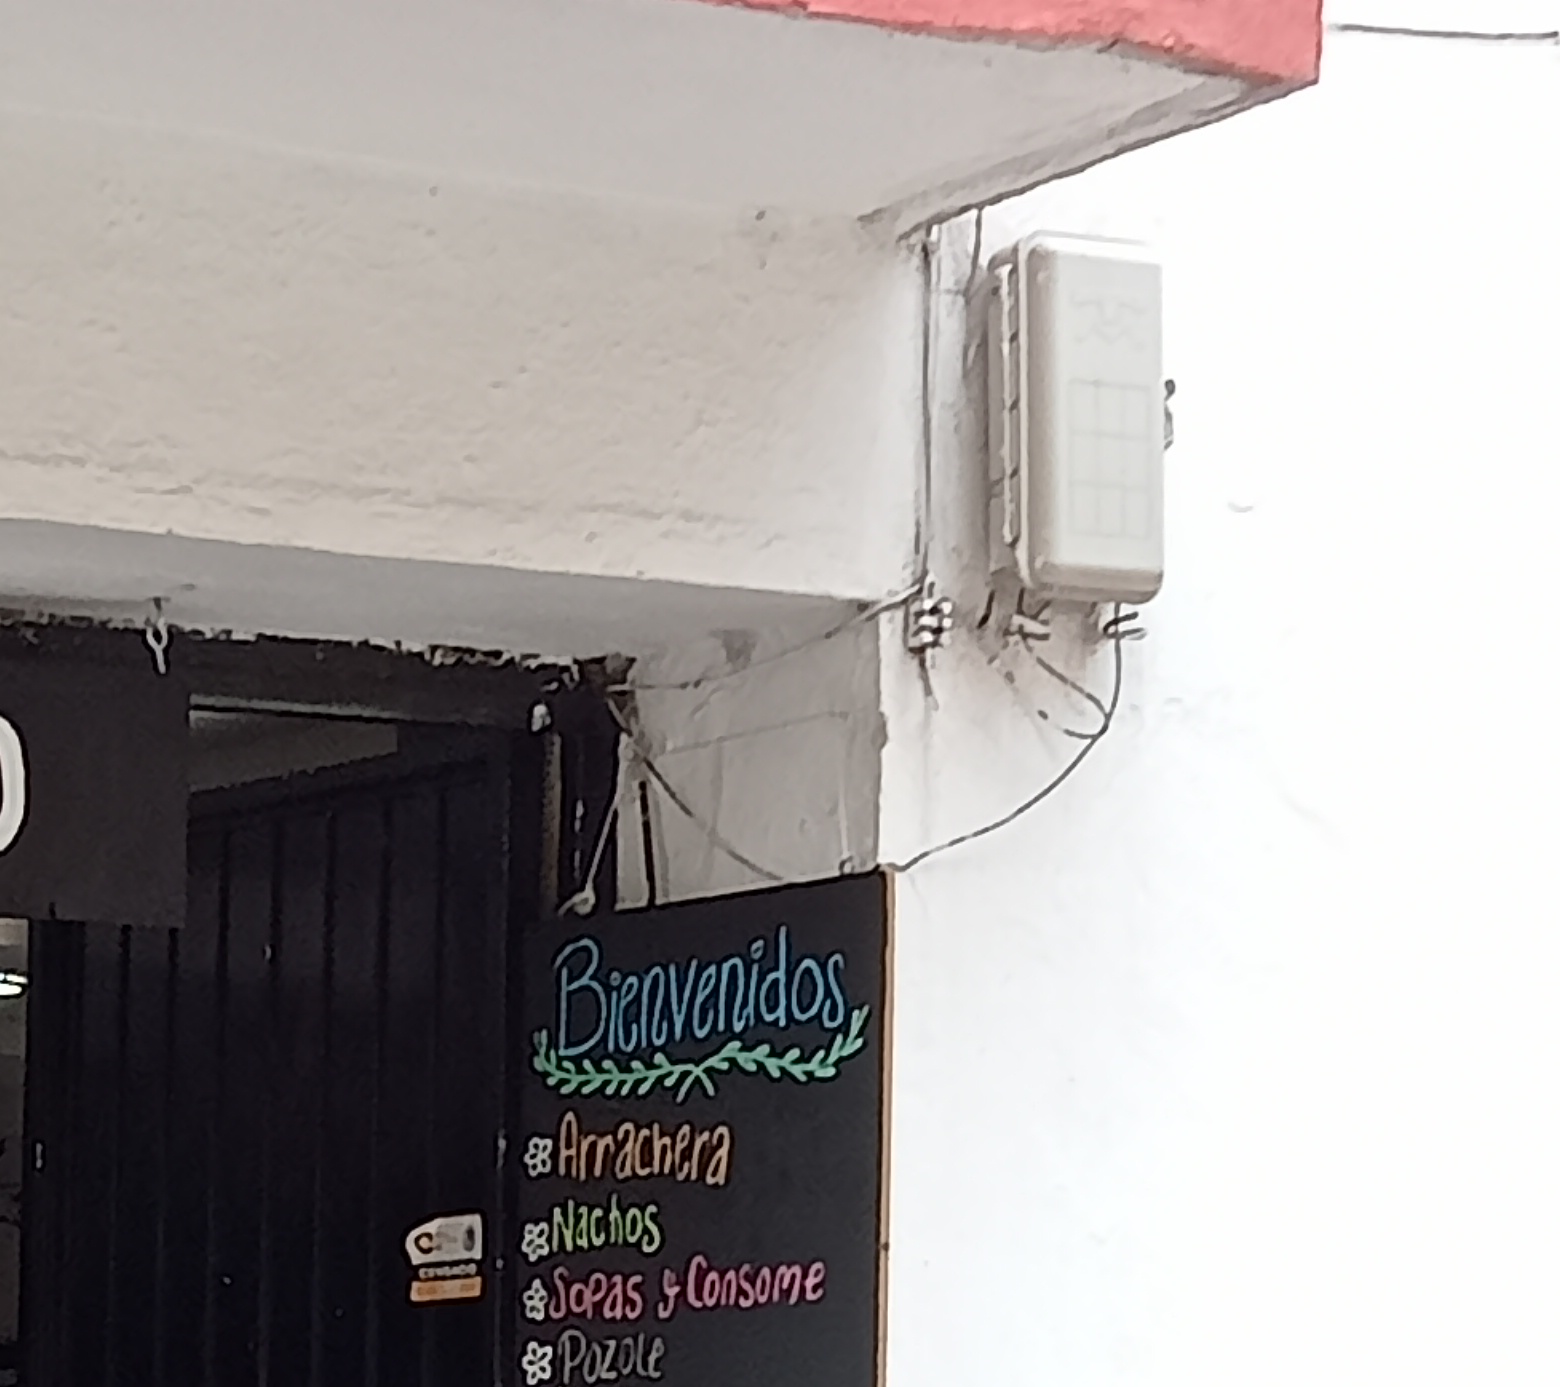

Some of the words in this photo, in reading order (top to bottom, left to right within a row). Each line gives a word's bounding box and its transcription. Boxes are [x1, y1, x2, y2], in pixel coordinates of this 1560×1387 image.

[553, 924, 845, 1056] Bienvenidos
[557, 1111, 730, 1186] Arrachera
[551, 1194, 661, 1253] Nachos
[686, 1254, 827, 1308] Consome
[556, 1330, 665, 1384] Pozole
